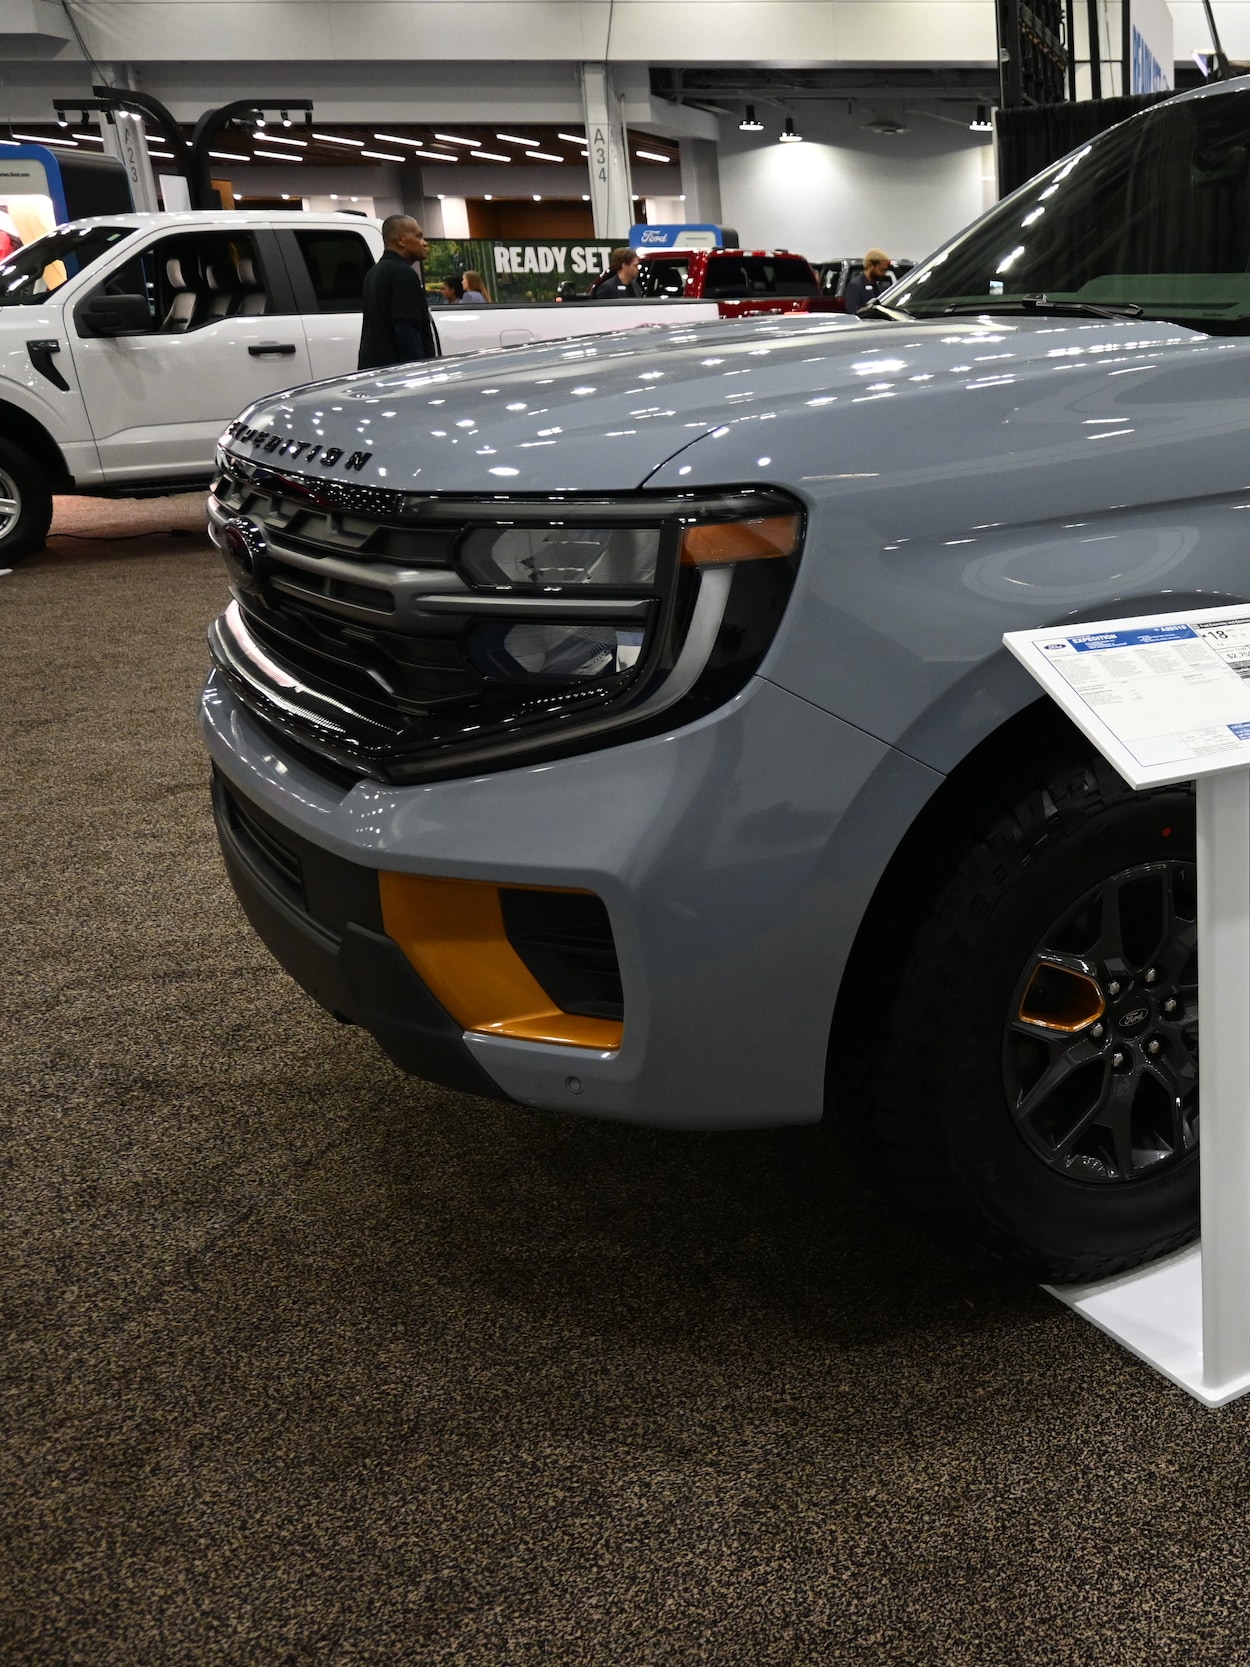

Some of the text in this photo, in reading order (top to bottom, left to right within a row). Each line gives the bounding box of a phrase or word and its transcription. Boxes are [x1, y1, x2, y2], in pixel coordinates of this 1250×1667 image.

[594, 128, 607, 183] A34
[641, 230, 668, 243] Ford
[494, 247, 611, 273] READY SET
[1208, 630, 1228, 640] 18
